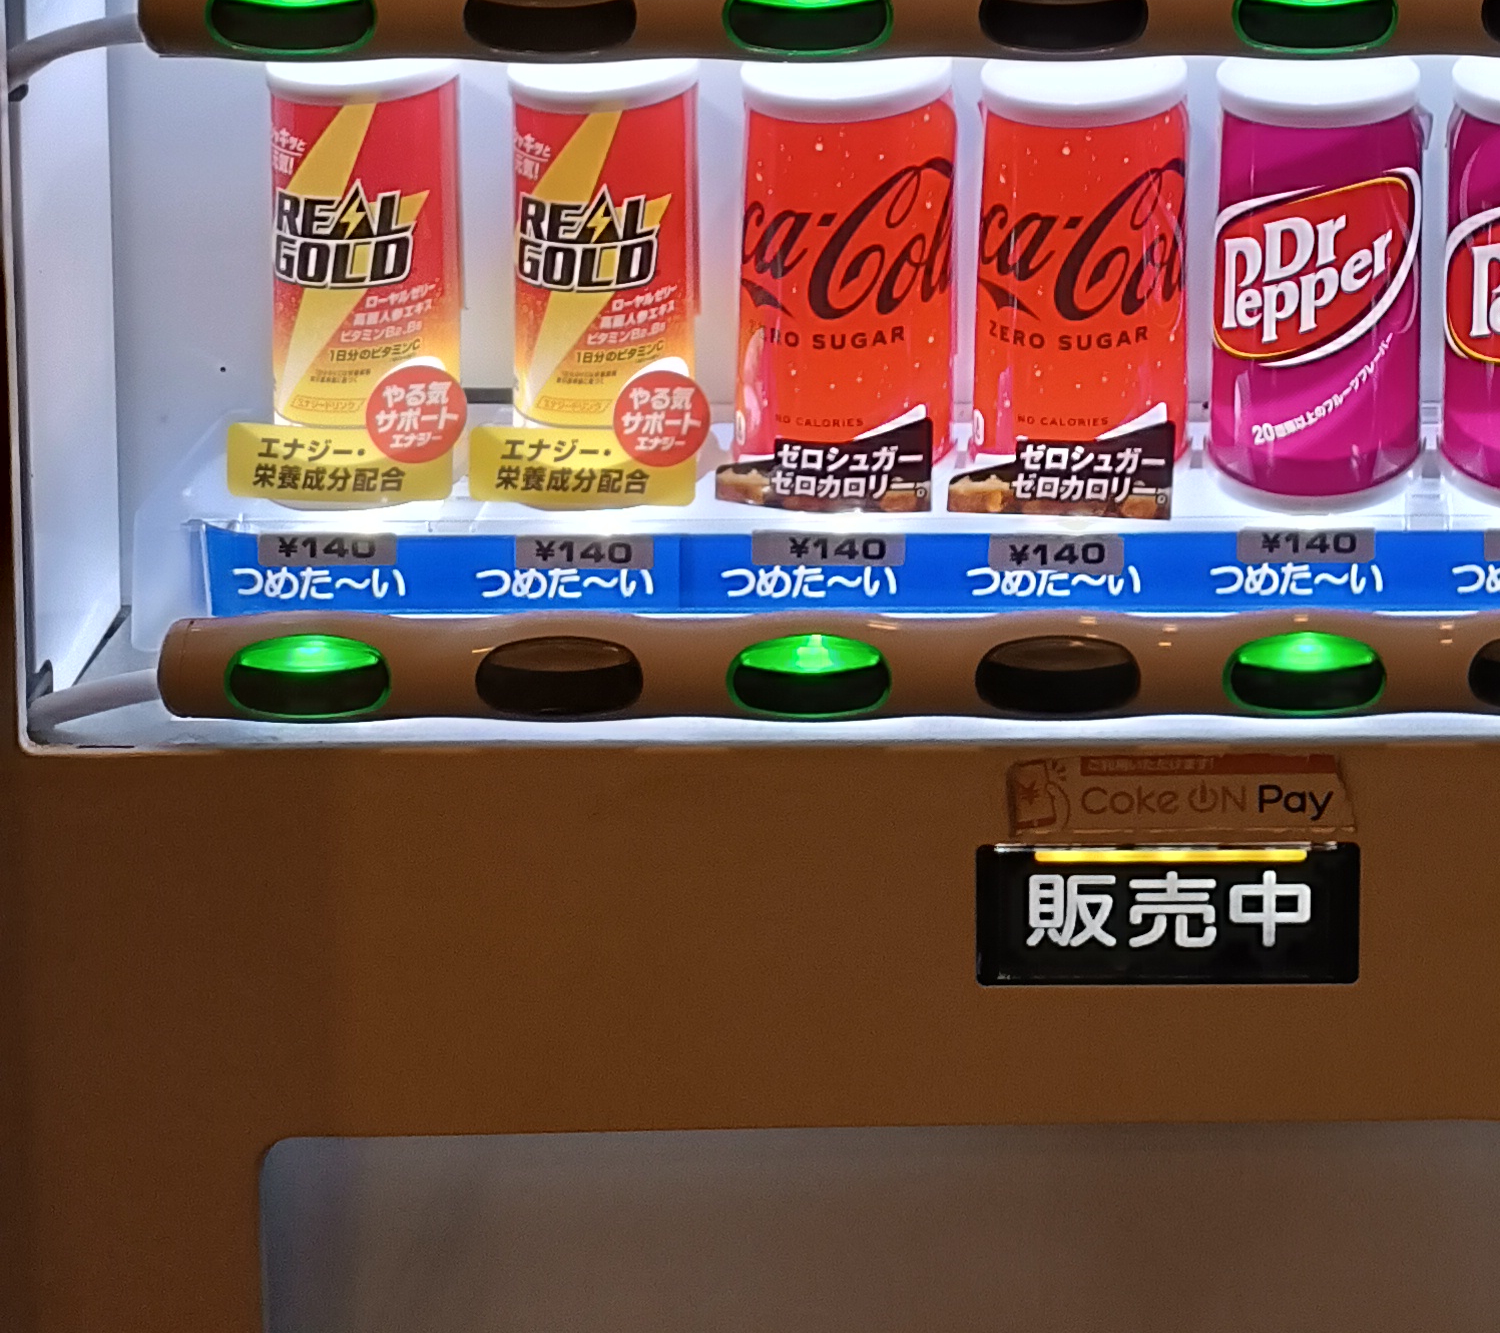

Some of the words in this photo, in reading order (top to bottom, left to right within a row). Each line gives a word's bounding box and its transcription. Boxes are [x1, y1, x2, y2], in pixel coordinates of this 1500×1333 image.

[276, 179, 414, 241] REAL
[1263, 214, 1347, 285] Dr
[519, 239, 660, 292] GOLD
[1058, 325, 1148, 352] SUGAR
[1020, 444, 1165, 474] ゼロシュガー
[495, 466, 650, 495] 栄養成分配合
[277, 537, 375, 561] ¥140
[789, 536, 886, 561] ¥140
[1010, 542, 1105, 565] ¥140
[1262, 530, 1358, 555] ¥140
[1080, 785, 1179, 815] Coke
[1258, 784, 1333, 821] Pay
[1026, 869, 1312, 947] 販売中
